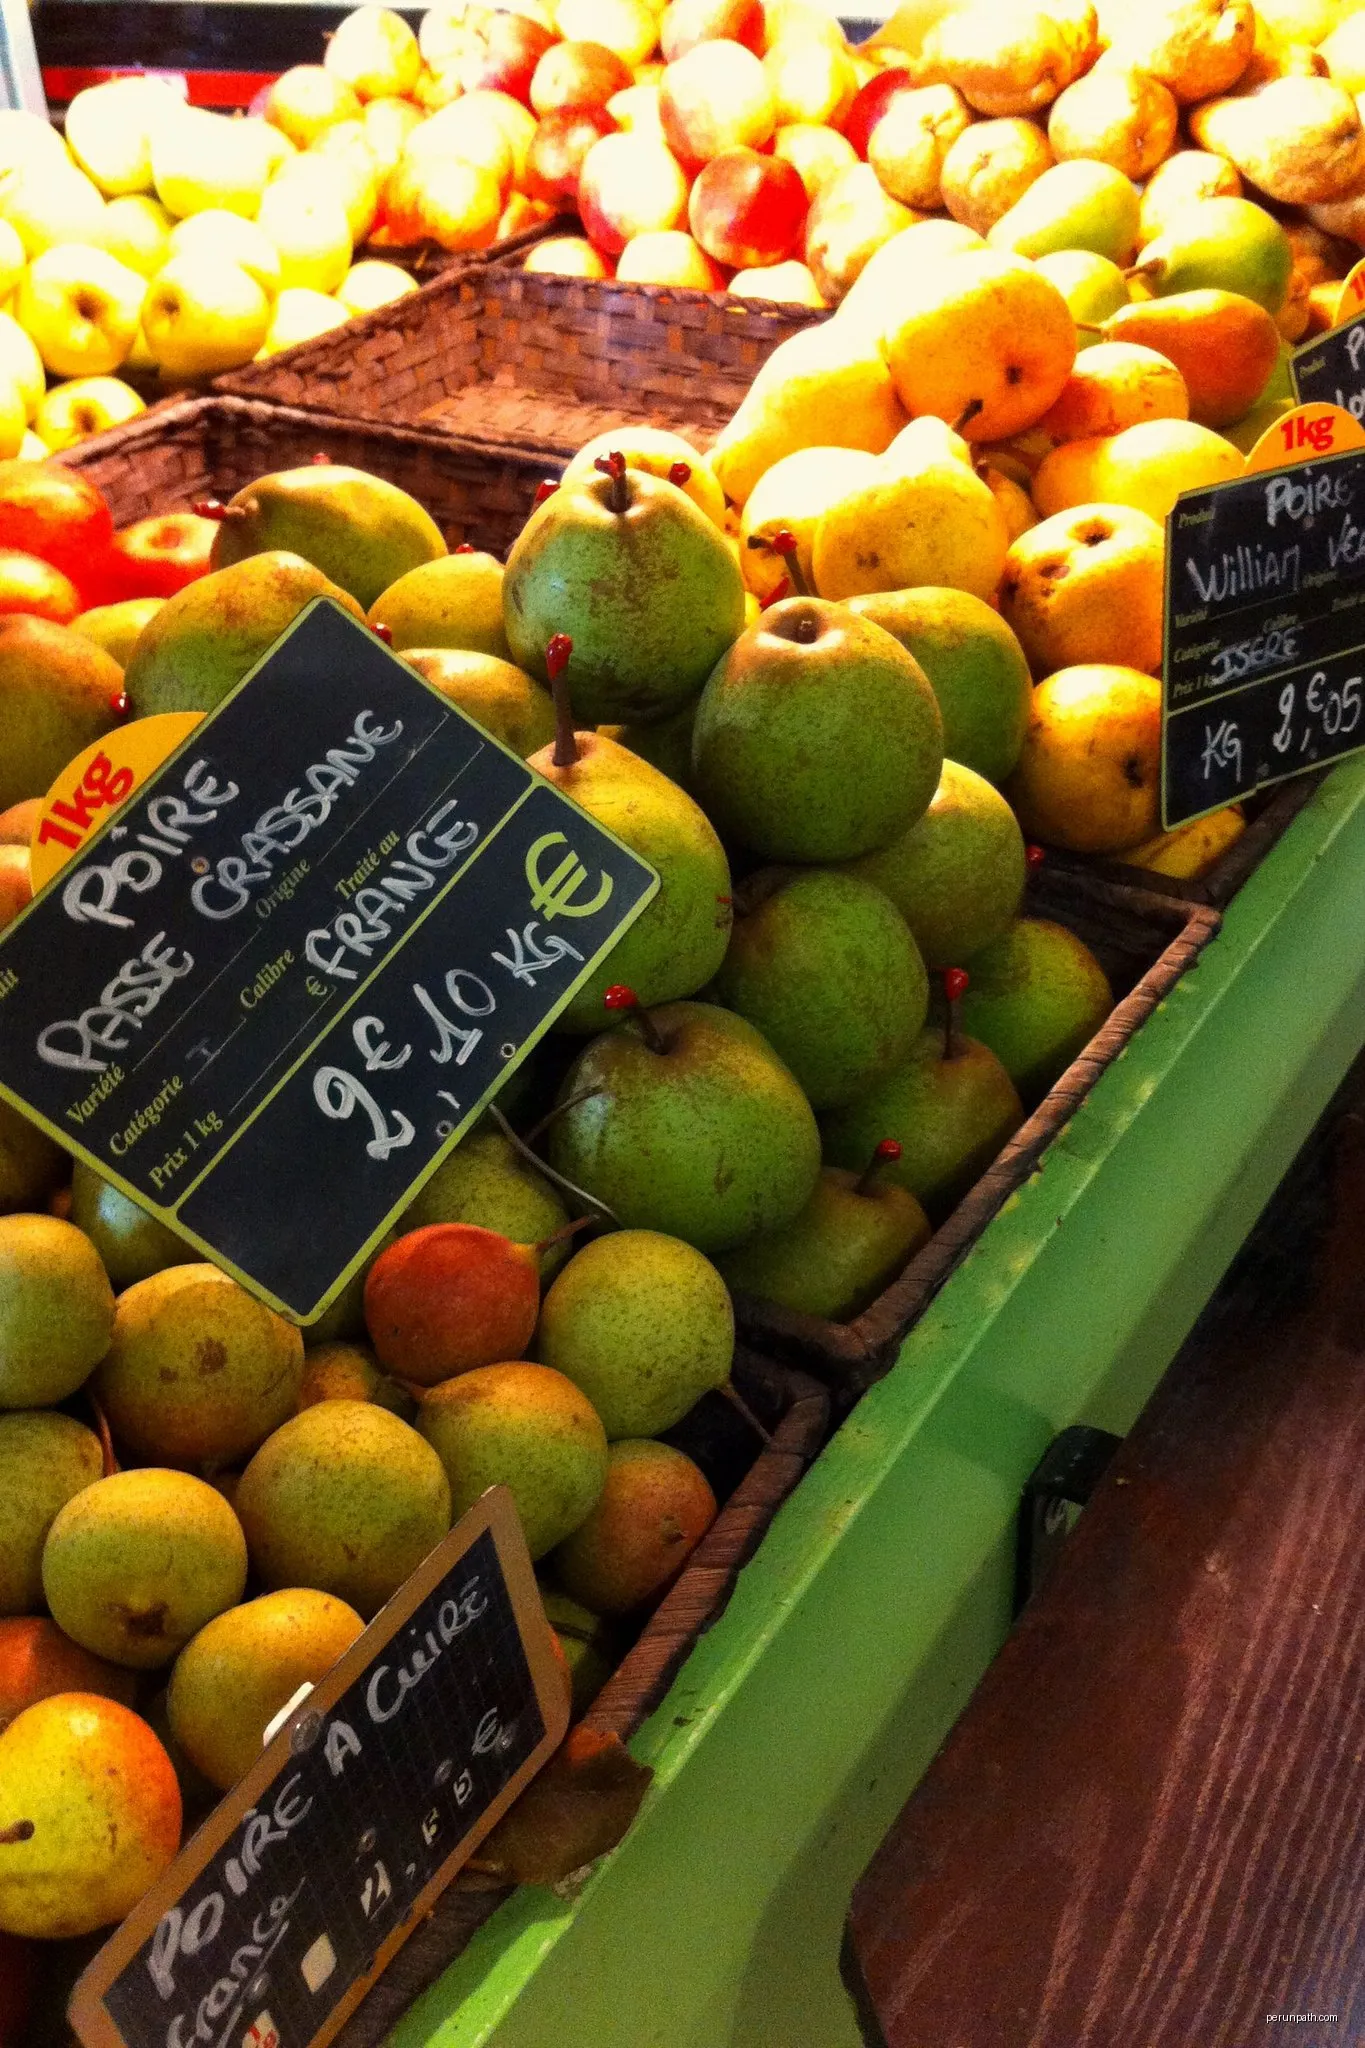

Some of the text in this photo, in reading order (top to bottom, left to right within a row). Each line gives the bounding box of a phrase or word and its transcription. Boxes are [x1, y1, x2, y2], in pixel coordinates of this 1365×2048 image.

[37, 710, 404, 1071] PASSE CRASSANE
[38, 751, 134, 850] 1kg
[305, 799, 479, 979] FRANCE
[334, 830, 401, 900] Traité au
[525, 831, 614, 921] €
[65, 857, 312, 1126] Variété Origine
[109, 1073, 185, 1156] Catégorie
[239, 948, 296, 1009] Calibre
[149, 1149, 190, 1190] Prix
[182, 1131, 200, 1151] 1
[193, 1109, 224, 1141] kg
[148, 1773, 314, 2001] POIRE
[324, 1719, 363, 1777] A
